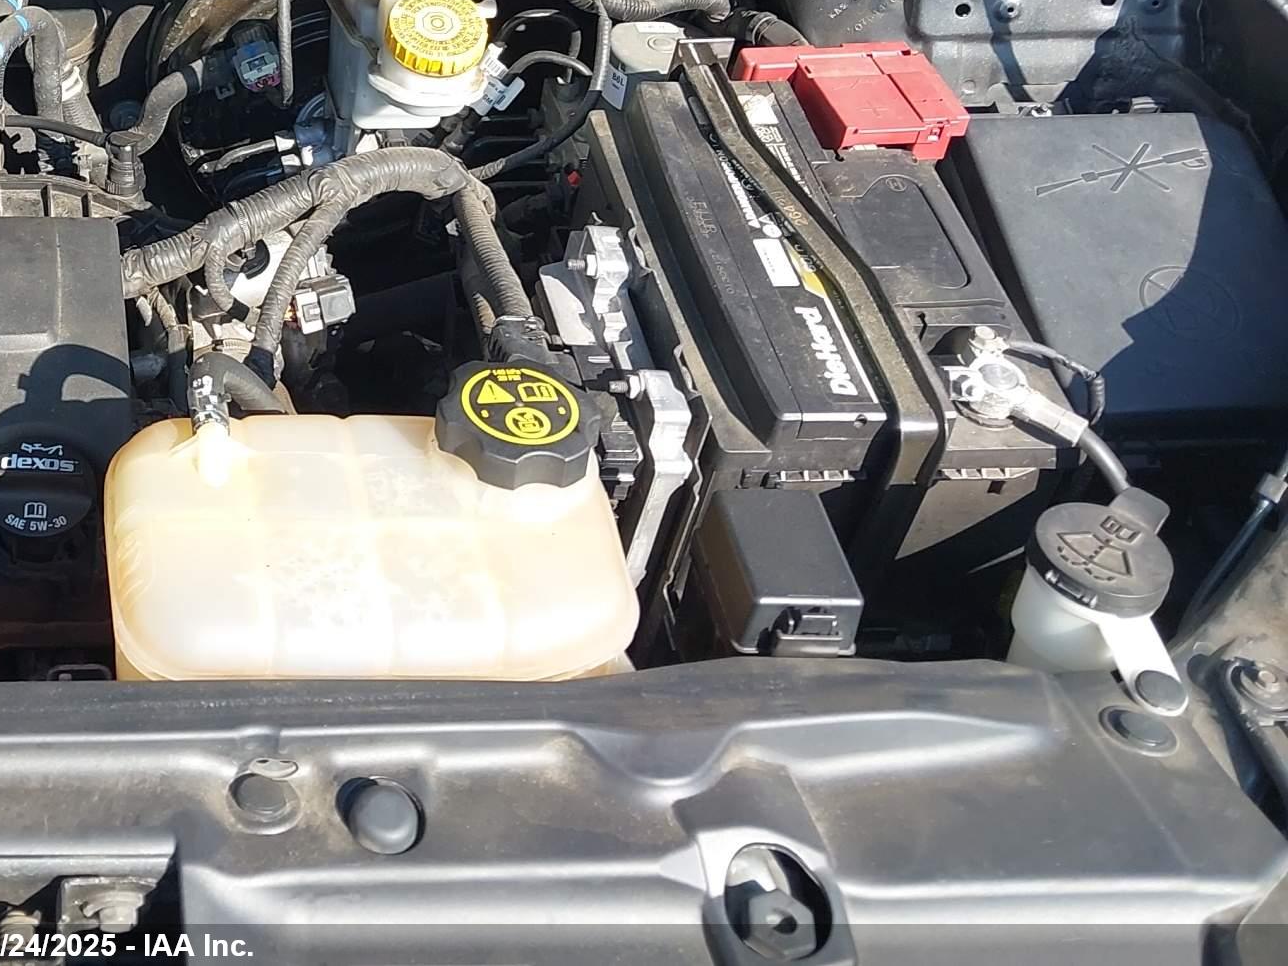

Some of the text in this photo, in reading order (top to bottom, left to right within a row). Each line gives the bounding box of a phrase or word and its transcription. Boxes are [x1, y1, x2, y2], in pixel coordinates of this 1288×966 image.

[794, 306, 858, 396] DieHard
[0, 454, 75, 472] dexos
[5, 514, 67, 531] SAE 5W-30
